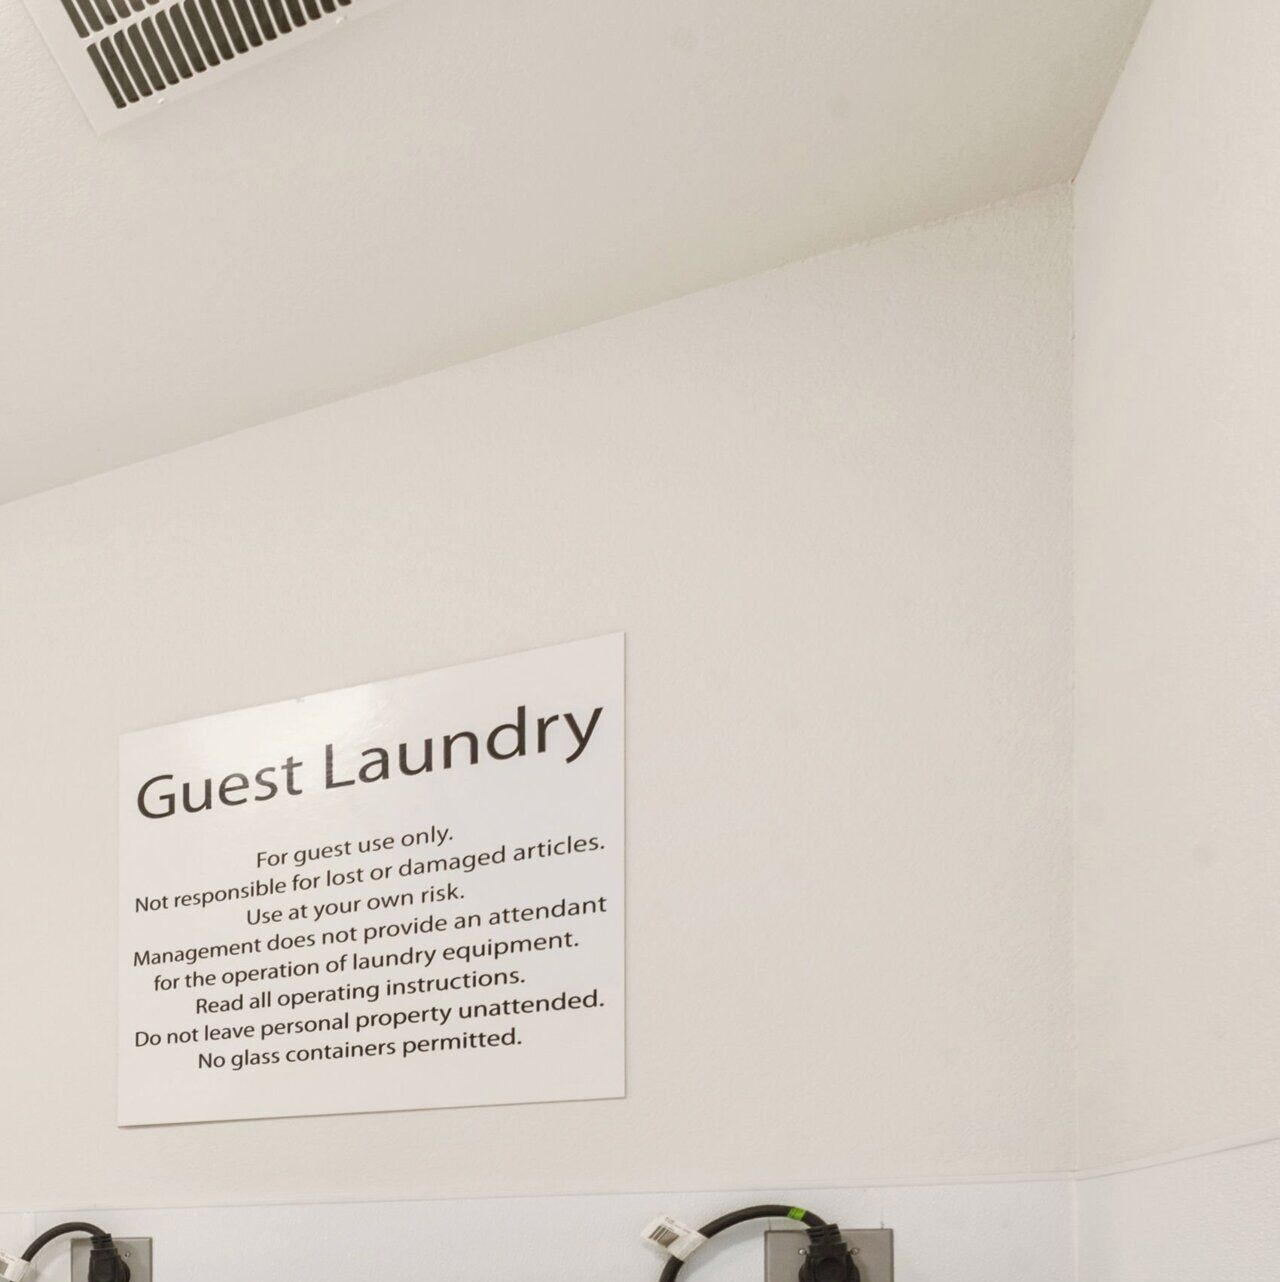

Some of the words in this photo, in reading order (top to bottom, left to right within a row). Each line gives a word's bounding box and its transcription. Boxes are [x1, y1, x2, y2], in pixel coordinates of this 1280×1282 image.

[137, 756, 303, 820] Guest
[325, 705, 604, 790] Laundry
[135, 895, 169, 913] Not
[174, 877, 287, 908] responsible
[292, 873, 321, 892] for
[326, 868, 364, 887] lost
[369, 865, 393, 881] or
[398, 844, 506, 877] damaged
[513, 835, 605, 862] articles.
[257, 851, 289, 869] For
[293, 840, 352, 868] guest
[358, 836, 395, 854] use
[401, 825, 453, 847] only.
[133, 938, 262, 967] Management
[266, 933, 316, 952] does
[322, 927, 358, 945] not
[364, 914, 448, 945] provide
[454, 914, 481, 930] an
[488, 896, 607, 926] attendant
[247, 908, 283, 926] Use
[288, 904, 308, 921] at
[313, 899, 362, 922] your
[366, 892, 414, 911] own
[421, 882, 465, 904] risk.
[153, 974, 180, 992] for
[184, 970, 217, 988] the
[221, 961, 320, 987] operation
[325, 953, 348, 973] of
[353, 946, 437, 971] laundry
[442, 931, 579, 963] equipment.
[135, 1031, 162, 1048] Do
[167, 1028, 199, 1045] not
[204, 1024, 255, 1041] leave
[261, 1011, 349, 1041] personal
[356, 1006, 453, 1033] property
[458, 988, 605, 1020] unattended.
[196, 993, 244, 1015] Read
[249, 990, 272, 1010] all
[277, 983, 380, 1010] operating
[386, 970, 526, 996] instructions.
[198, 1052, 226, 1069] No
[230, 1048, 281, 1071] glass
[285, 1041, 396, 1063] containers
[402, 1026, 522, 1059] permitted.
